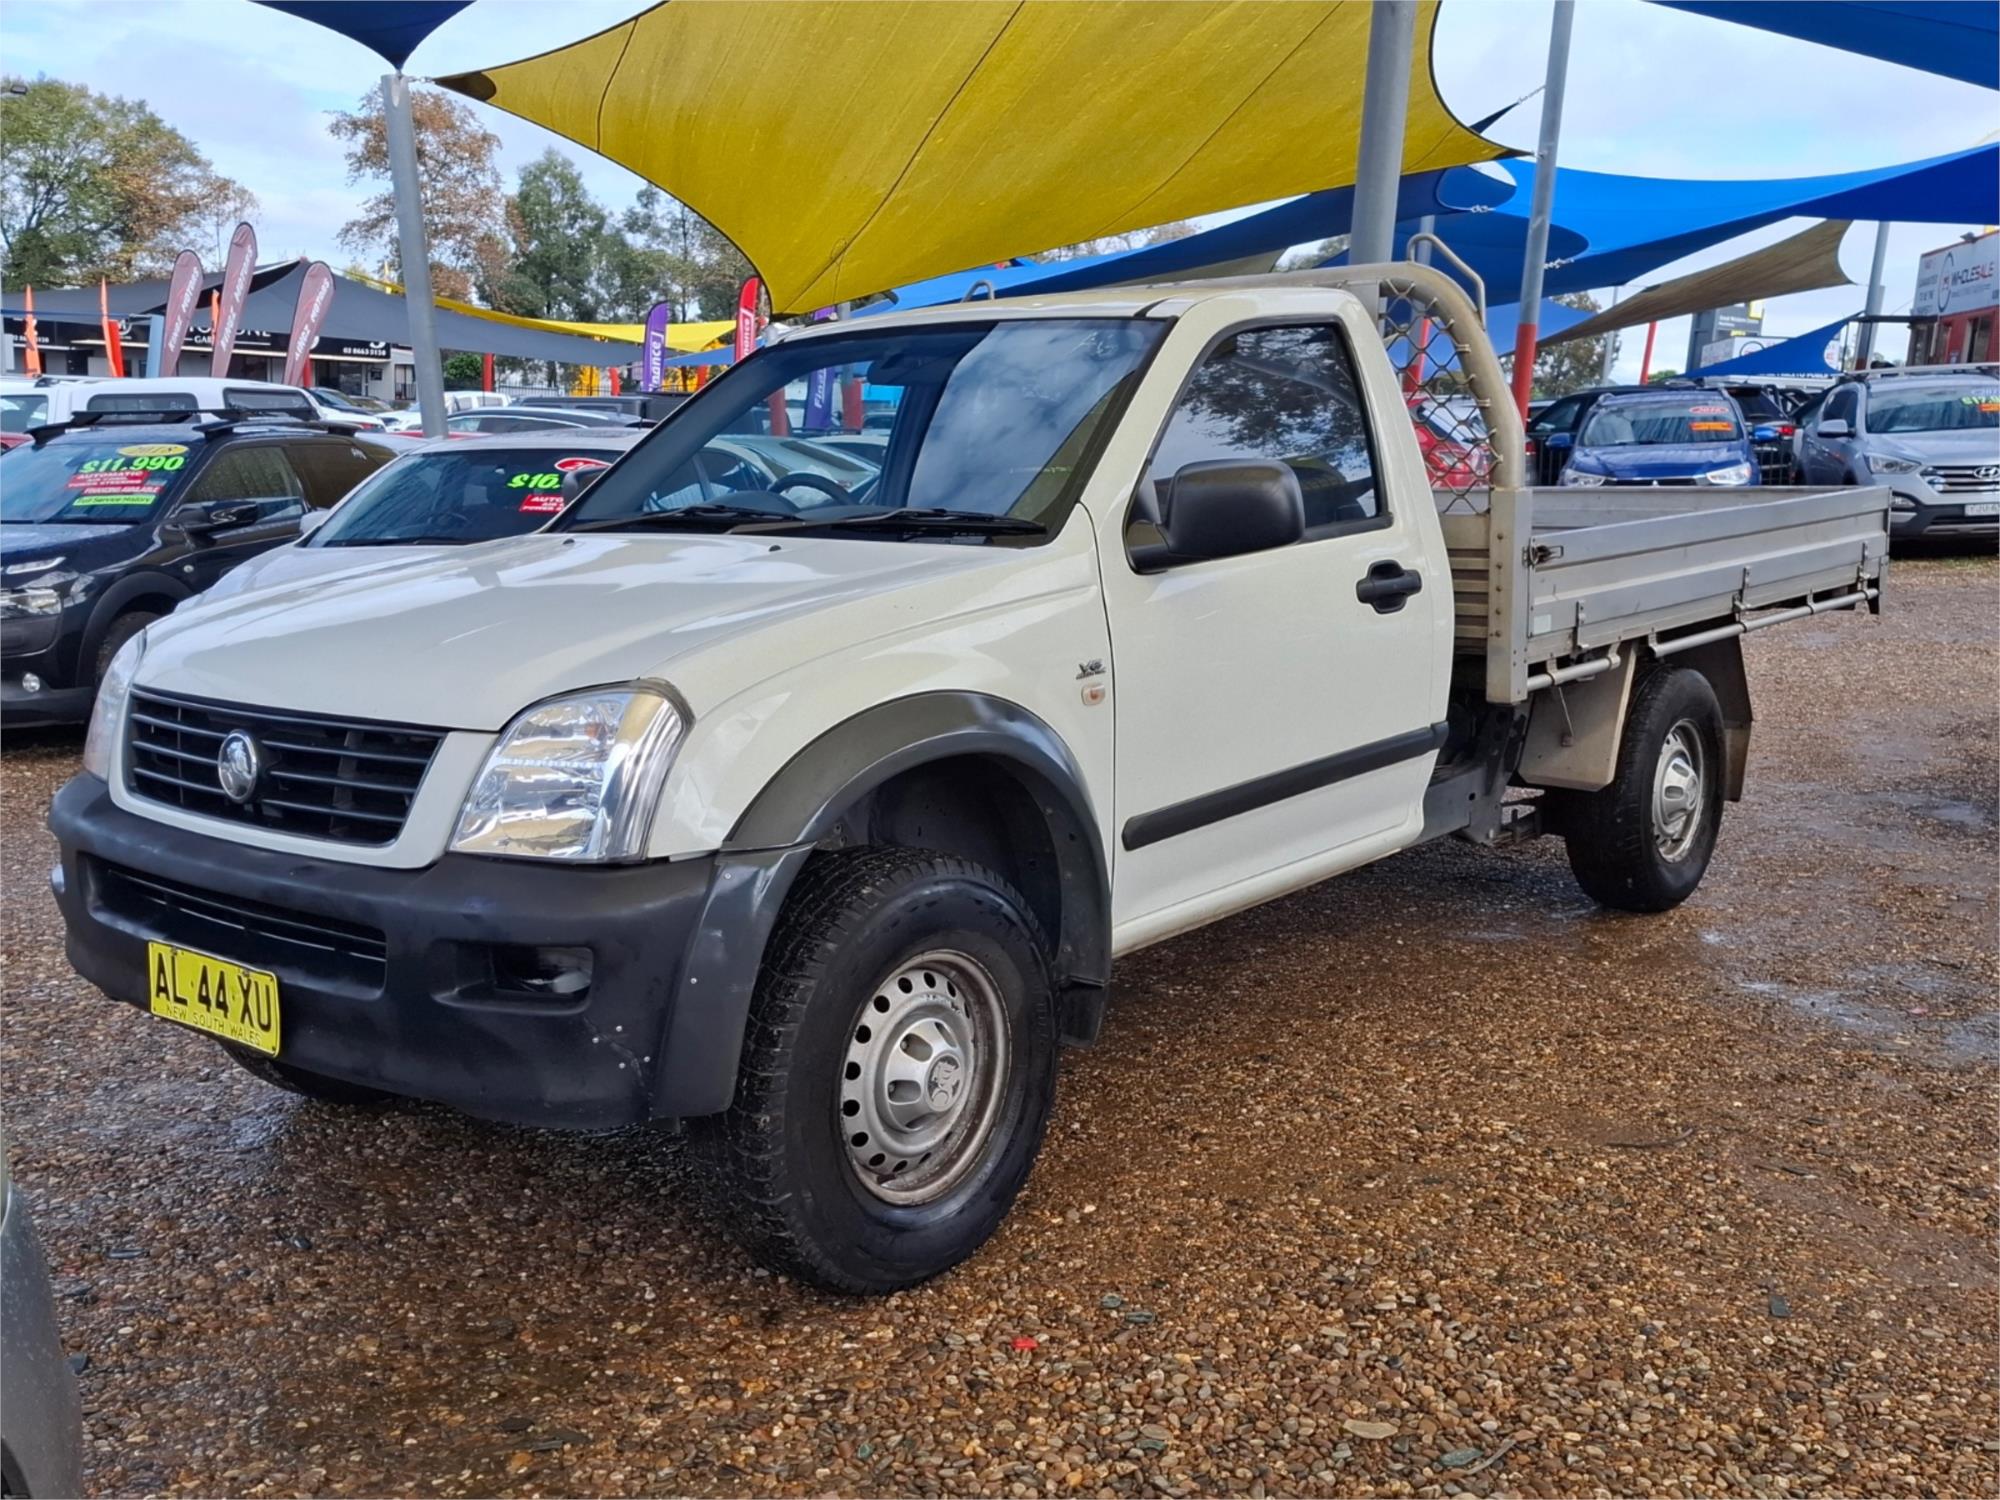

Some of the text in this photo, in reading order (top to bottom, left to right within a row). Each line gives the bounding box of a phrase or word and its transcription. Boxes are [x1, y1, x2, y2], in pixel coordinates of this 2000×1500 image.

[1952, 261, 1995, 286] WHOLESALE
[156, 952, 271, 1032] AL 44 XU
[167, 1006, 262, 1045] NEW SOUTH WALES
